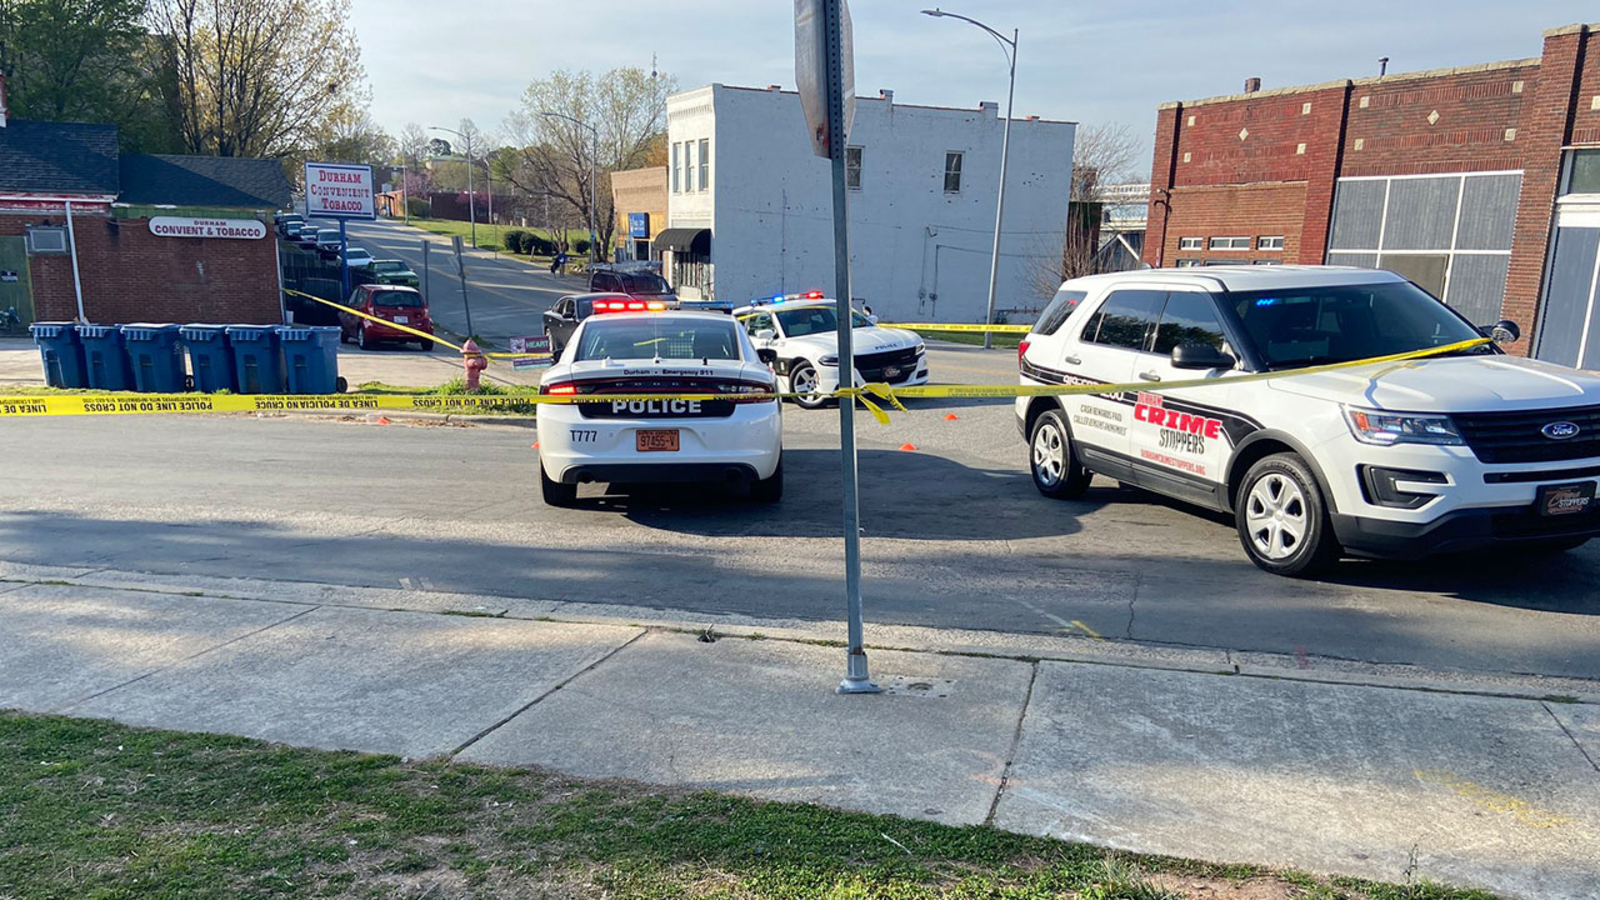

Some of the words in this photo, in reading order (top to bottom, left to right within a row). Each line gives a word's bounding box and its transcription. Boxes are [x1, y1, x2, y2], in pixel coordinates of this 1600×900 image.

[319, 170, 361, 184] DURHAM
[311, 184, 369, 198] CONVENIENT
[321, 198, 362, 211] TOBACCO
[155, 225, 204, 235] CONVIENT
[207, 227, 213, 236] &
[216, 227, 260, 237] TOBACCO
[19, 405, 47, 413] LINEA
[140, 403, 153, 411] DO
[180, 402, 212, 410] POLICE
[256, 401, 284, 409] CRUCE
[286, 401, 298, 409] NO
[300, 401, 335, 409] POLICIA
[352, 400, 378, 408] LINEA
[612, 399, 702, 413] POLICE
[4, 405, 16, 414] DE
[1134, 404, 1222, 440] CRIME
[1552, 425, 1573, 435] Ford
[570, 430, 597, 442] T777
[1159, 429, 1204, 454] STOPPERS
